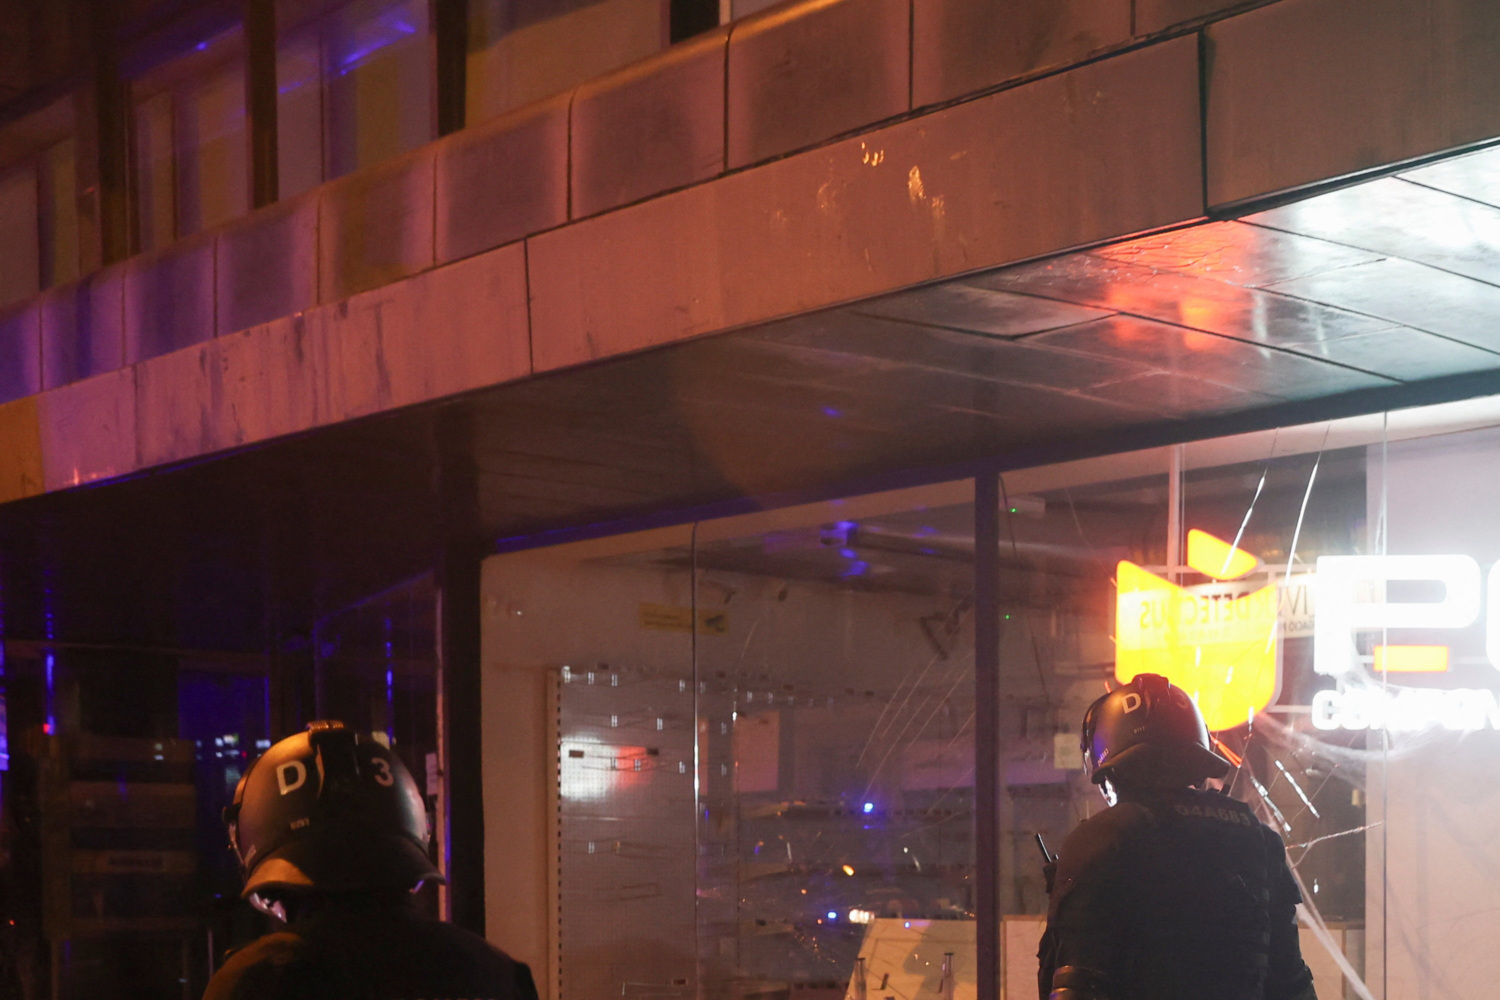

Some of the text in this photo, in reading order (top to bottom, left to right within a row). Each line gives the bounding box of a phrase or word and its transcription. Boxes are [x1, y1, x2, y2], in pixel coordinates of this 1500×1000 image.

[1122, 693, 1142, 714] D
[277, 758, 394, 795] D 3
